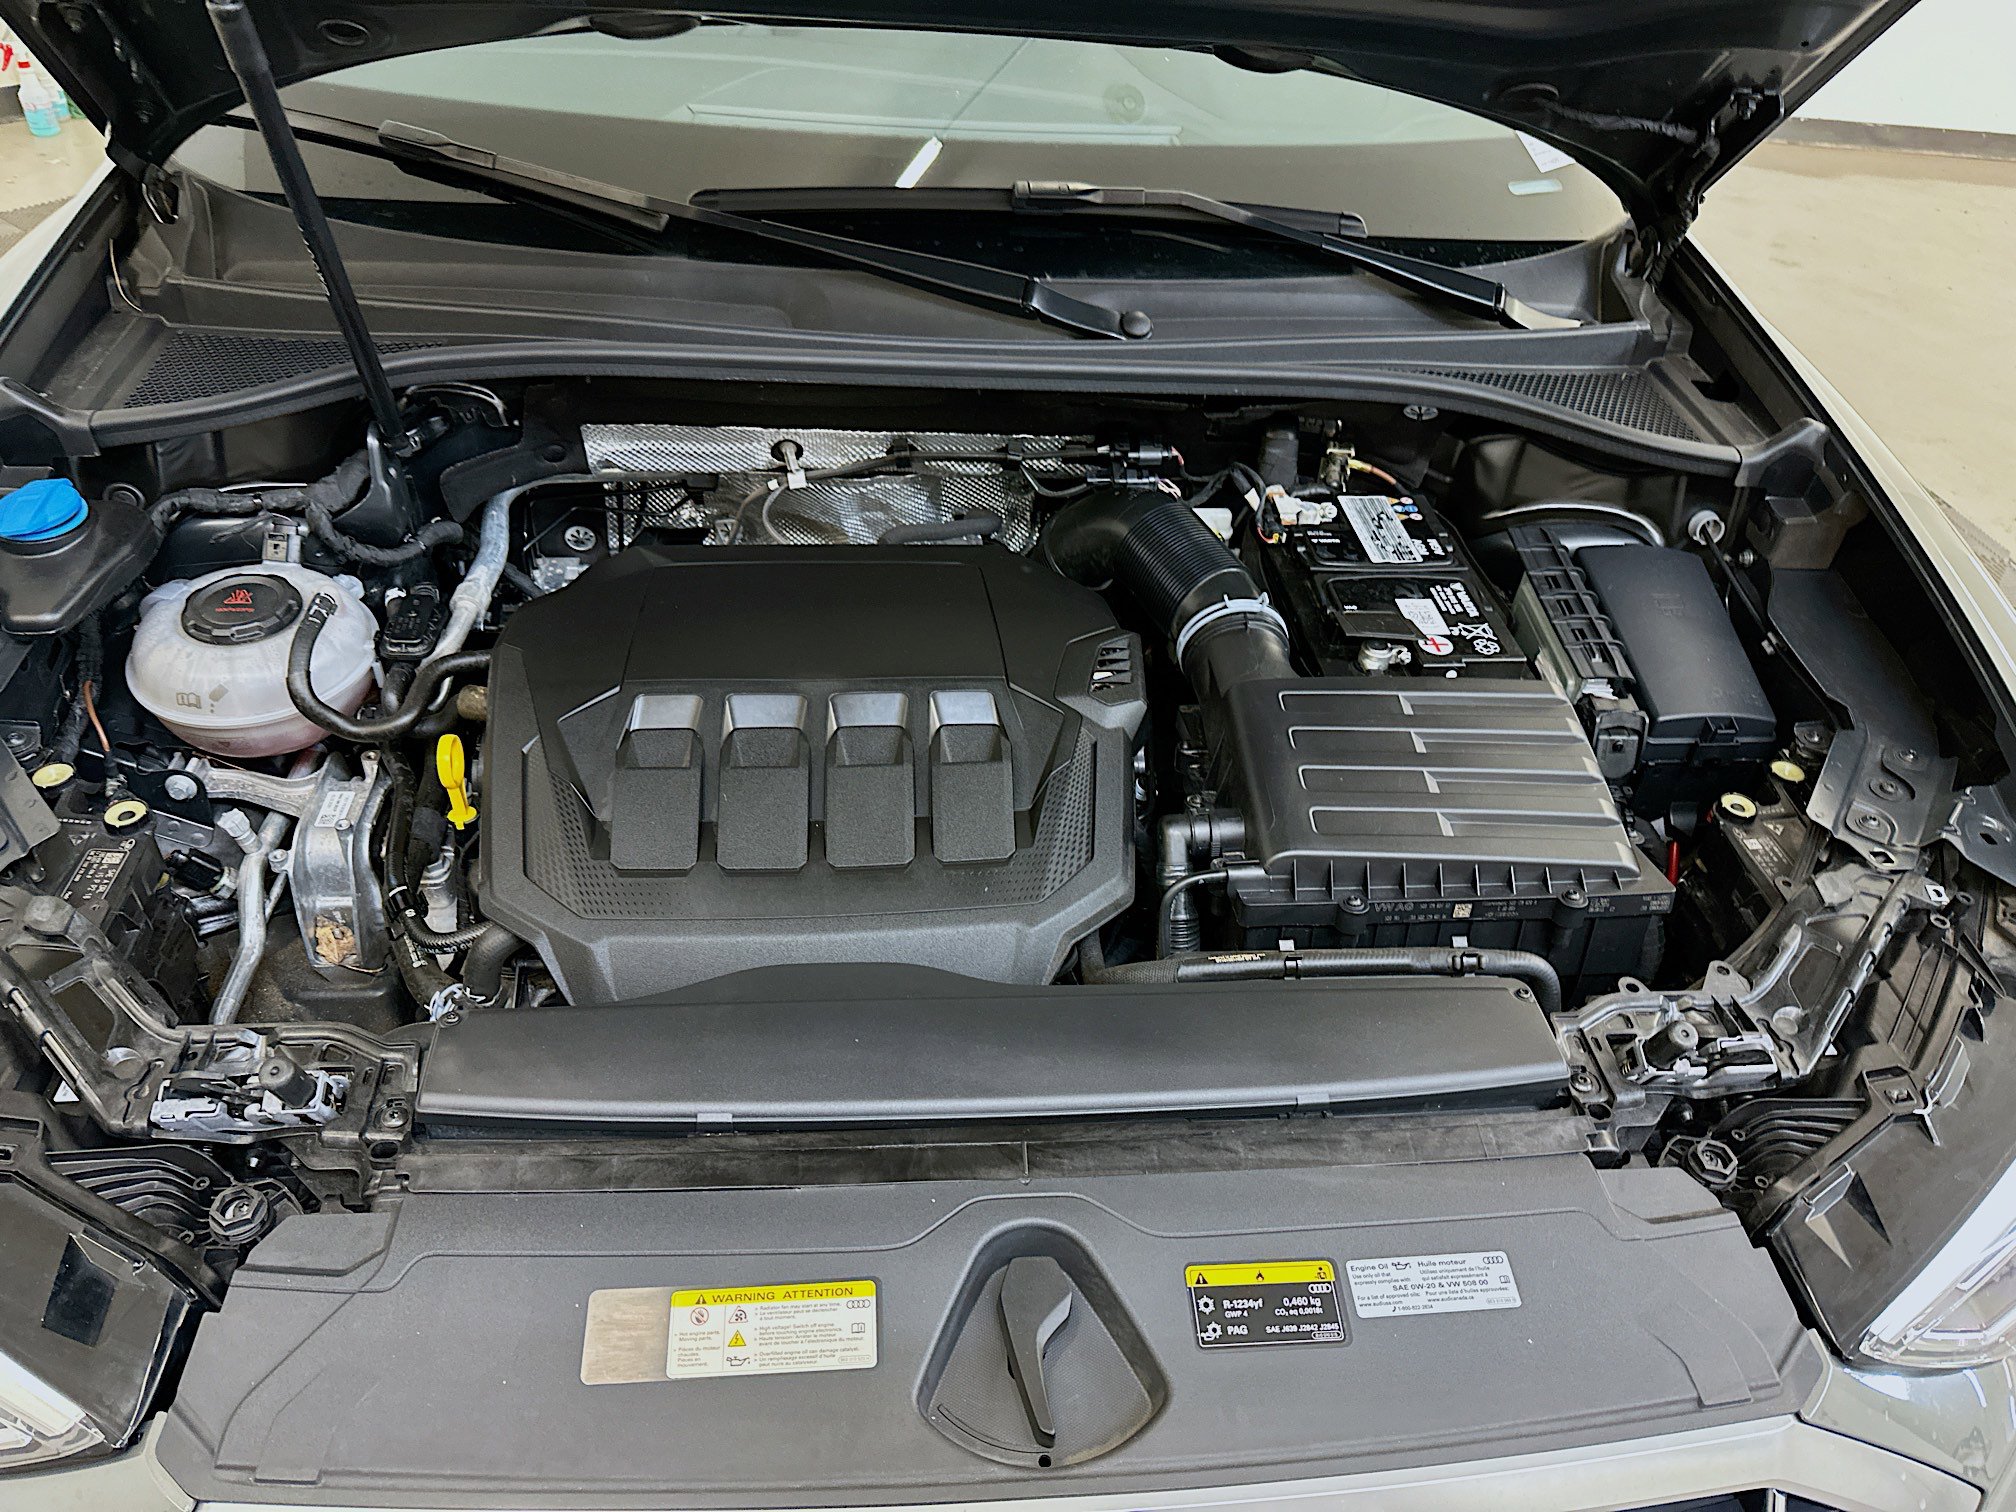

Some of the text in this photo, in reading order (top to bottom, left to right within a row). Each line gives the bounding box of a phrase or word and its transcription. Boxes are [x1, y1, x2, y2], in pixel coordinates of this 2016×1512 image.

[1350, 1264, 1376, 1273] Engine
[1417, 1258, 1466, 1268] Huile moteur
[1410, 1282, 1436, 1291] 0W-20
[712, 1287, 853, 1303] WARNING ATTENTION
[1223, 1298, 1263, 1311] R-1234yf
[1283, 1296, 1321, 1308] 0,460 kg
[1225, 1310, 1243, 1318] GWP
[1227, 1325, 1248, 1336] PAG
[1265, 1325, 1280, 1334] SAE
[1282, 1324, 1298, 1333] J639
[1299, 1323, 1318, 1332] J2842
